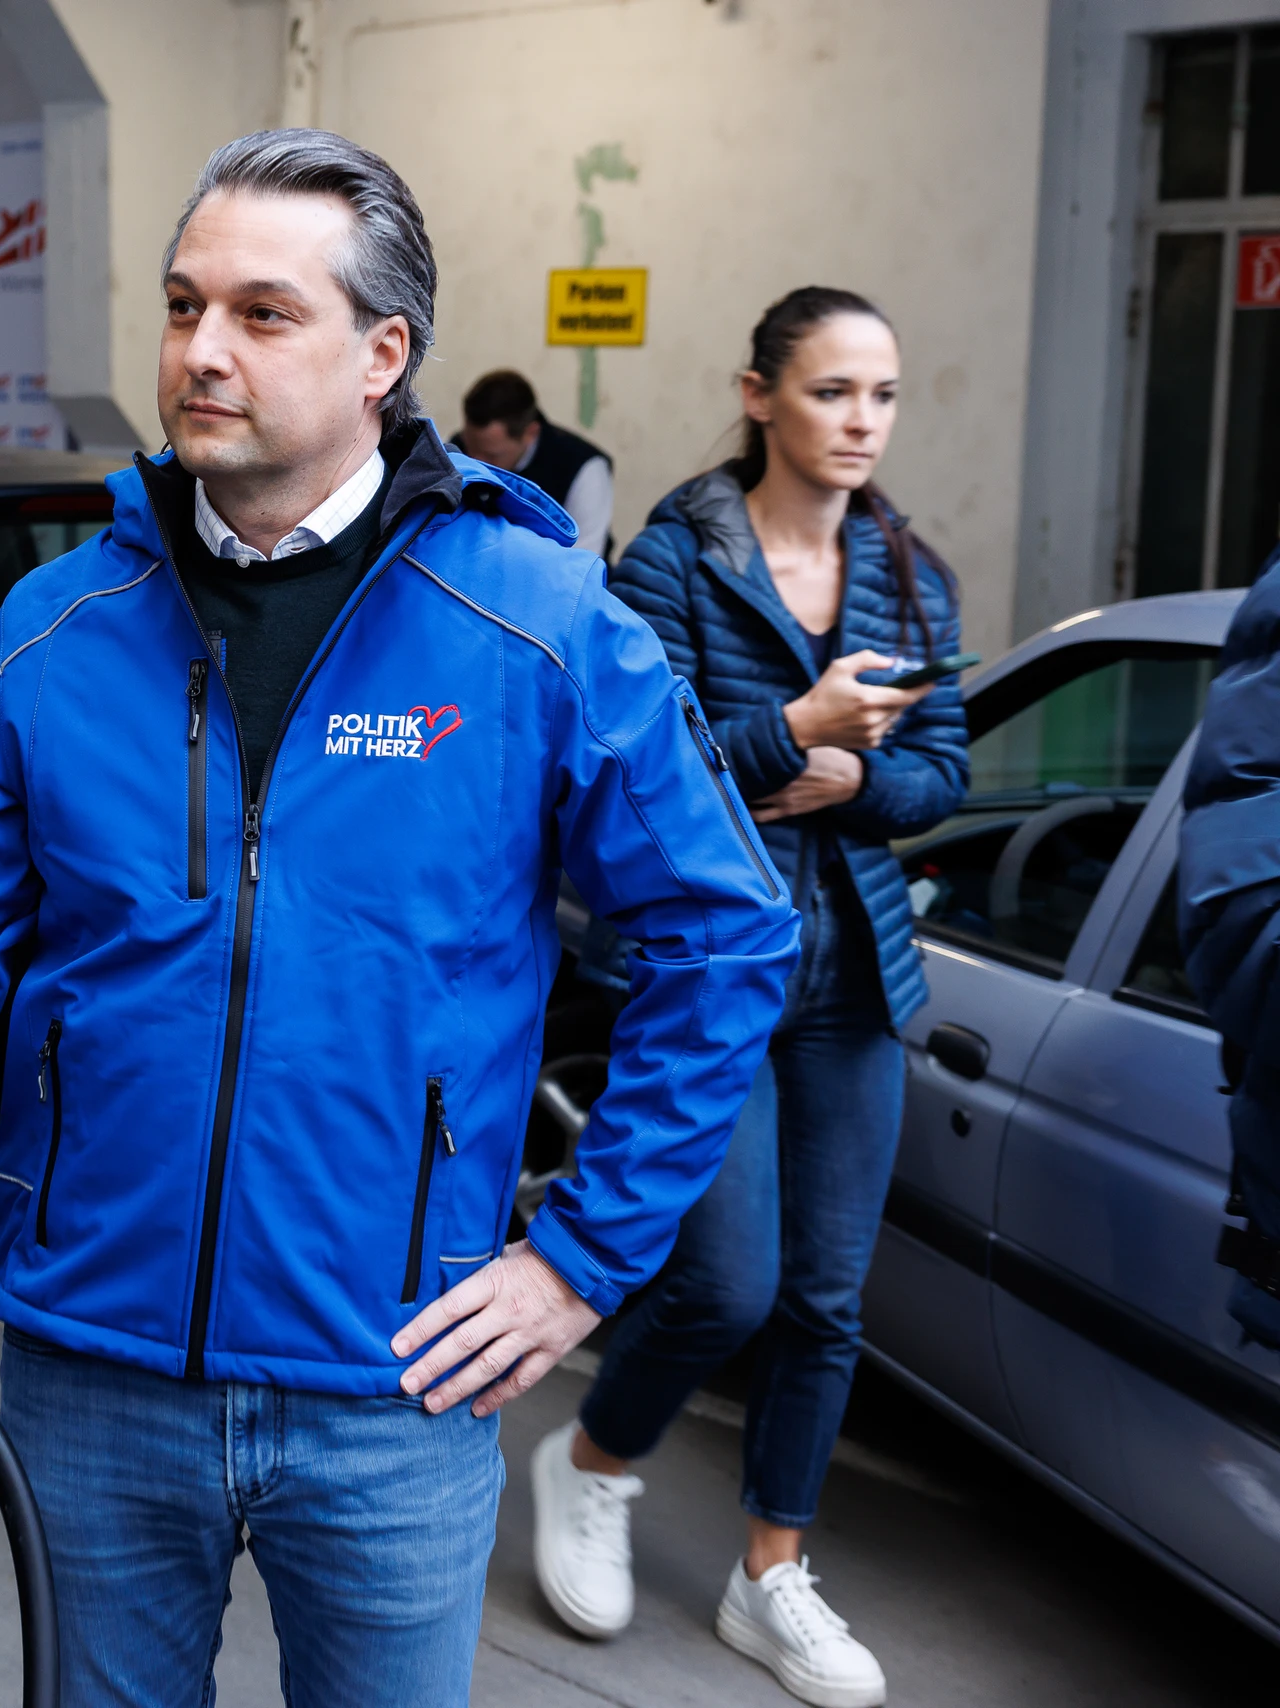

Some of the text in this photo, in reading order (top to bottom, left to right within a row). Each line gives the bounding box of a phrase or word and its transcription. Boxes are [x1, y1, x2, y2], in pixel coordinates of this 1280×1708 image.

[326, 713, 424, 739] POLITIK
[324, 736, 422, 758] MIT HERZ
